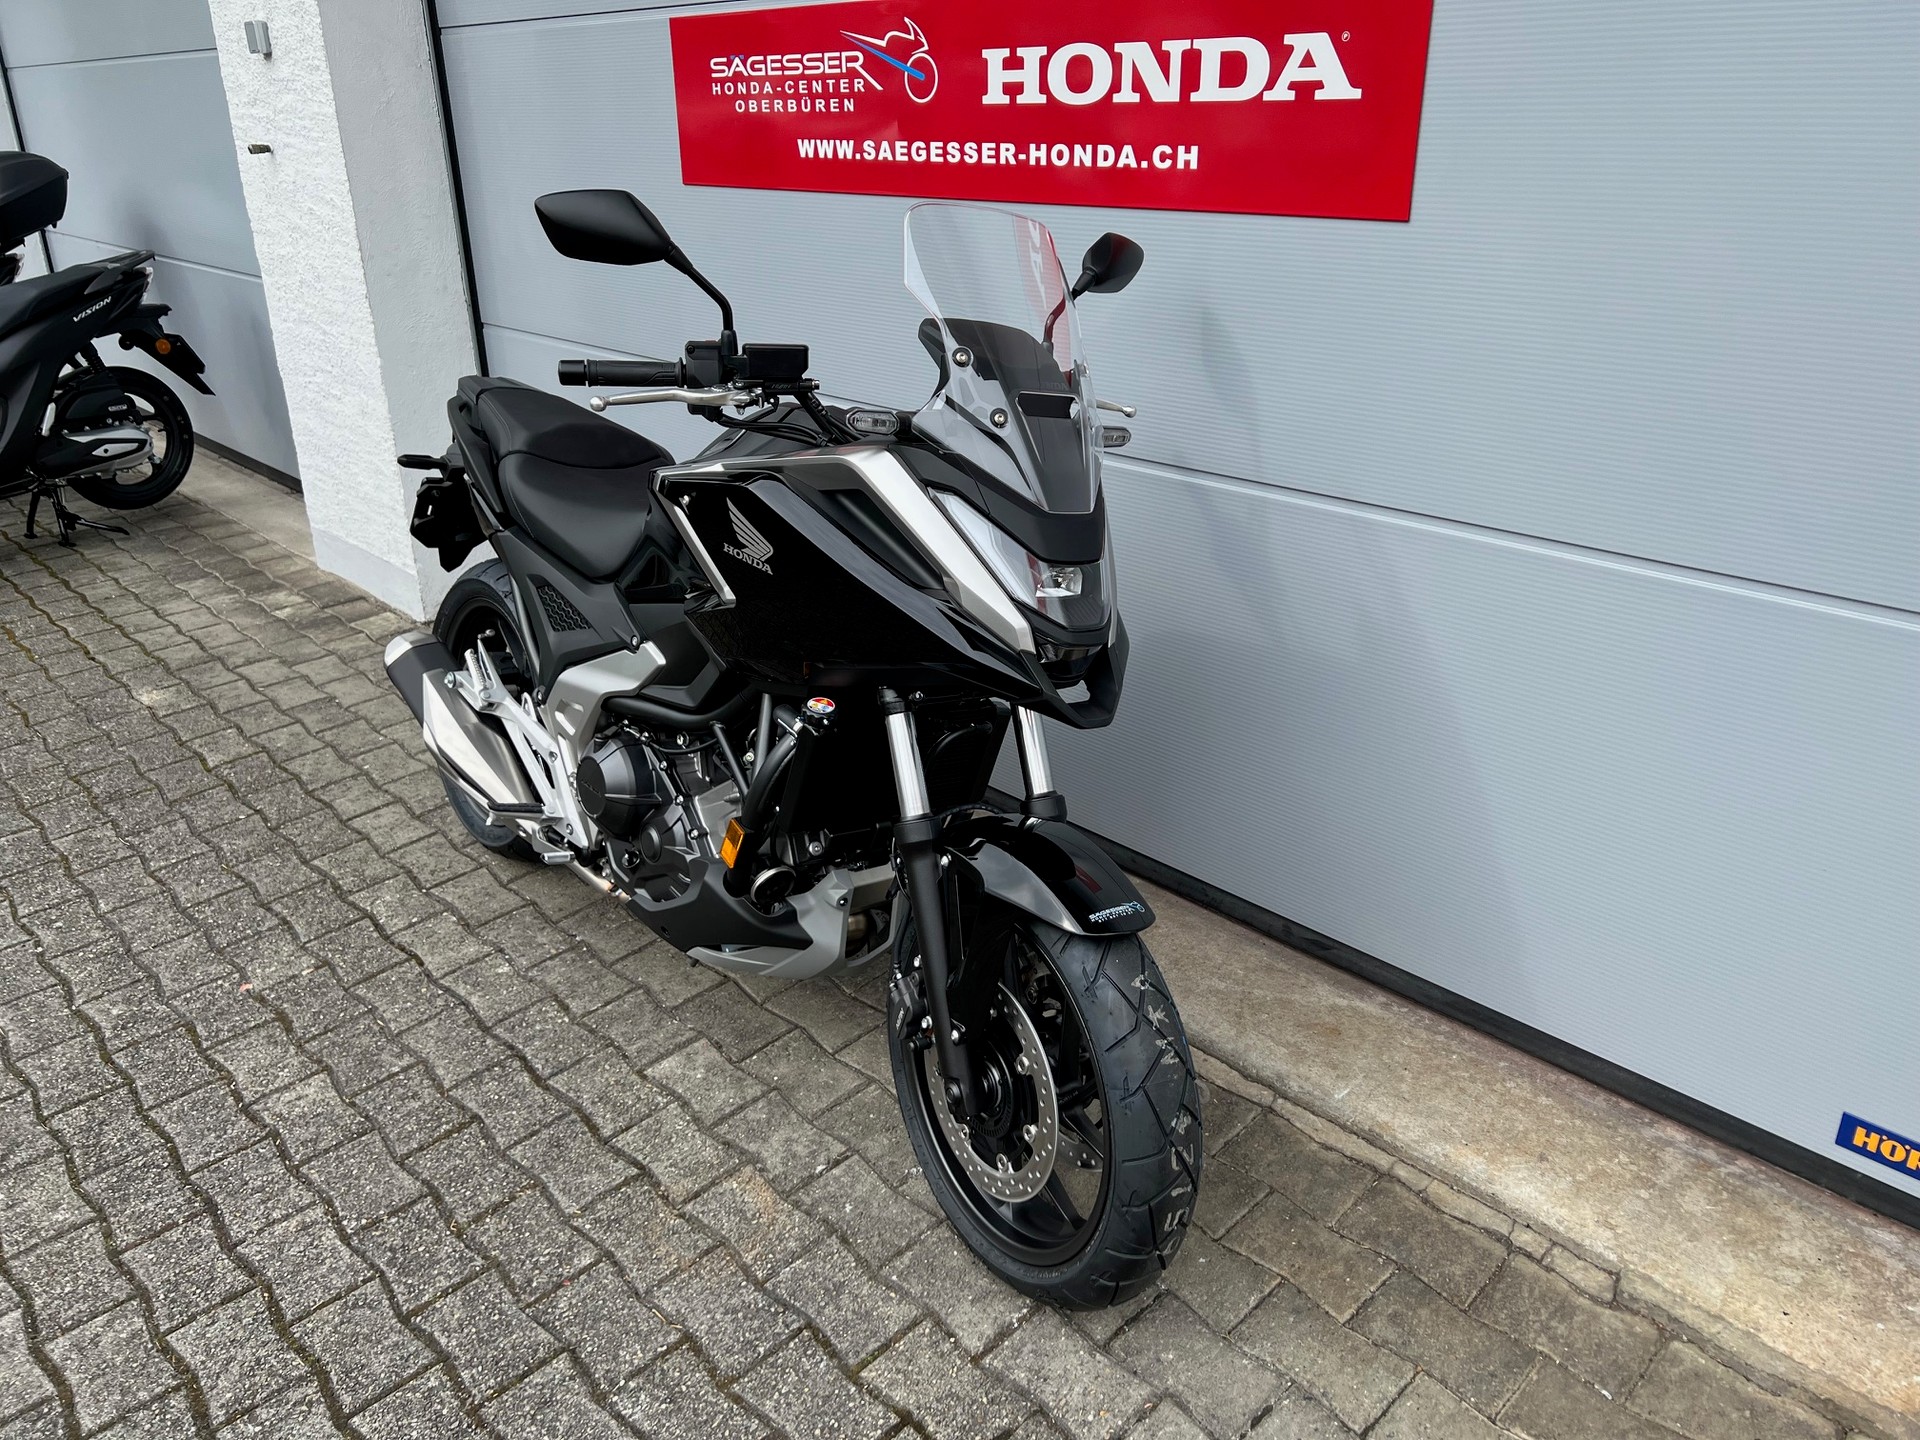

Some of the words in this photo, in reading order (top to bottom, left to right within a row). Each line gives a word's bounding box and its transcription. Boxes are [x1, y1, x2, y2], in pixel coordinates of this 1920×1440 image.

[710, 51, 883, 90] SÄGESSER
[982, 32, 1362, 105] HONDA
[712, 78, 865, 95] HONDA-CENTER
[735, 97, 854, 112] OBERBÜREN
[797, 138, 1199, 170] WWW.SAEGESSER-HONDA.CH
[73, 296, 111, 322] VISION
[723, 542, 774, 575] HONDA
